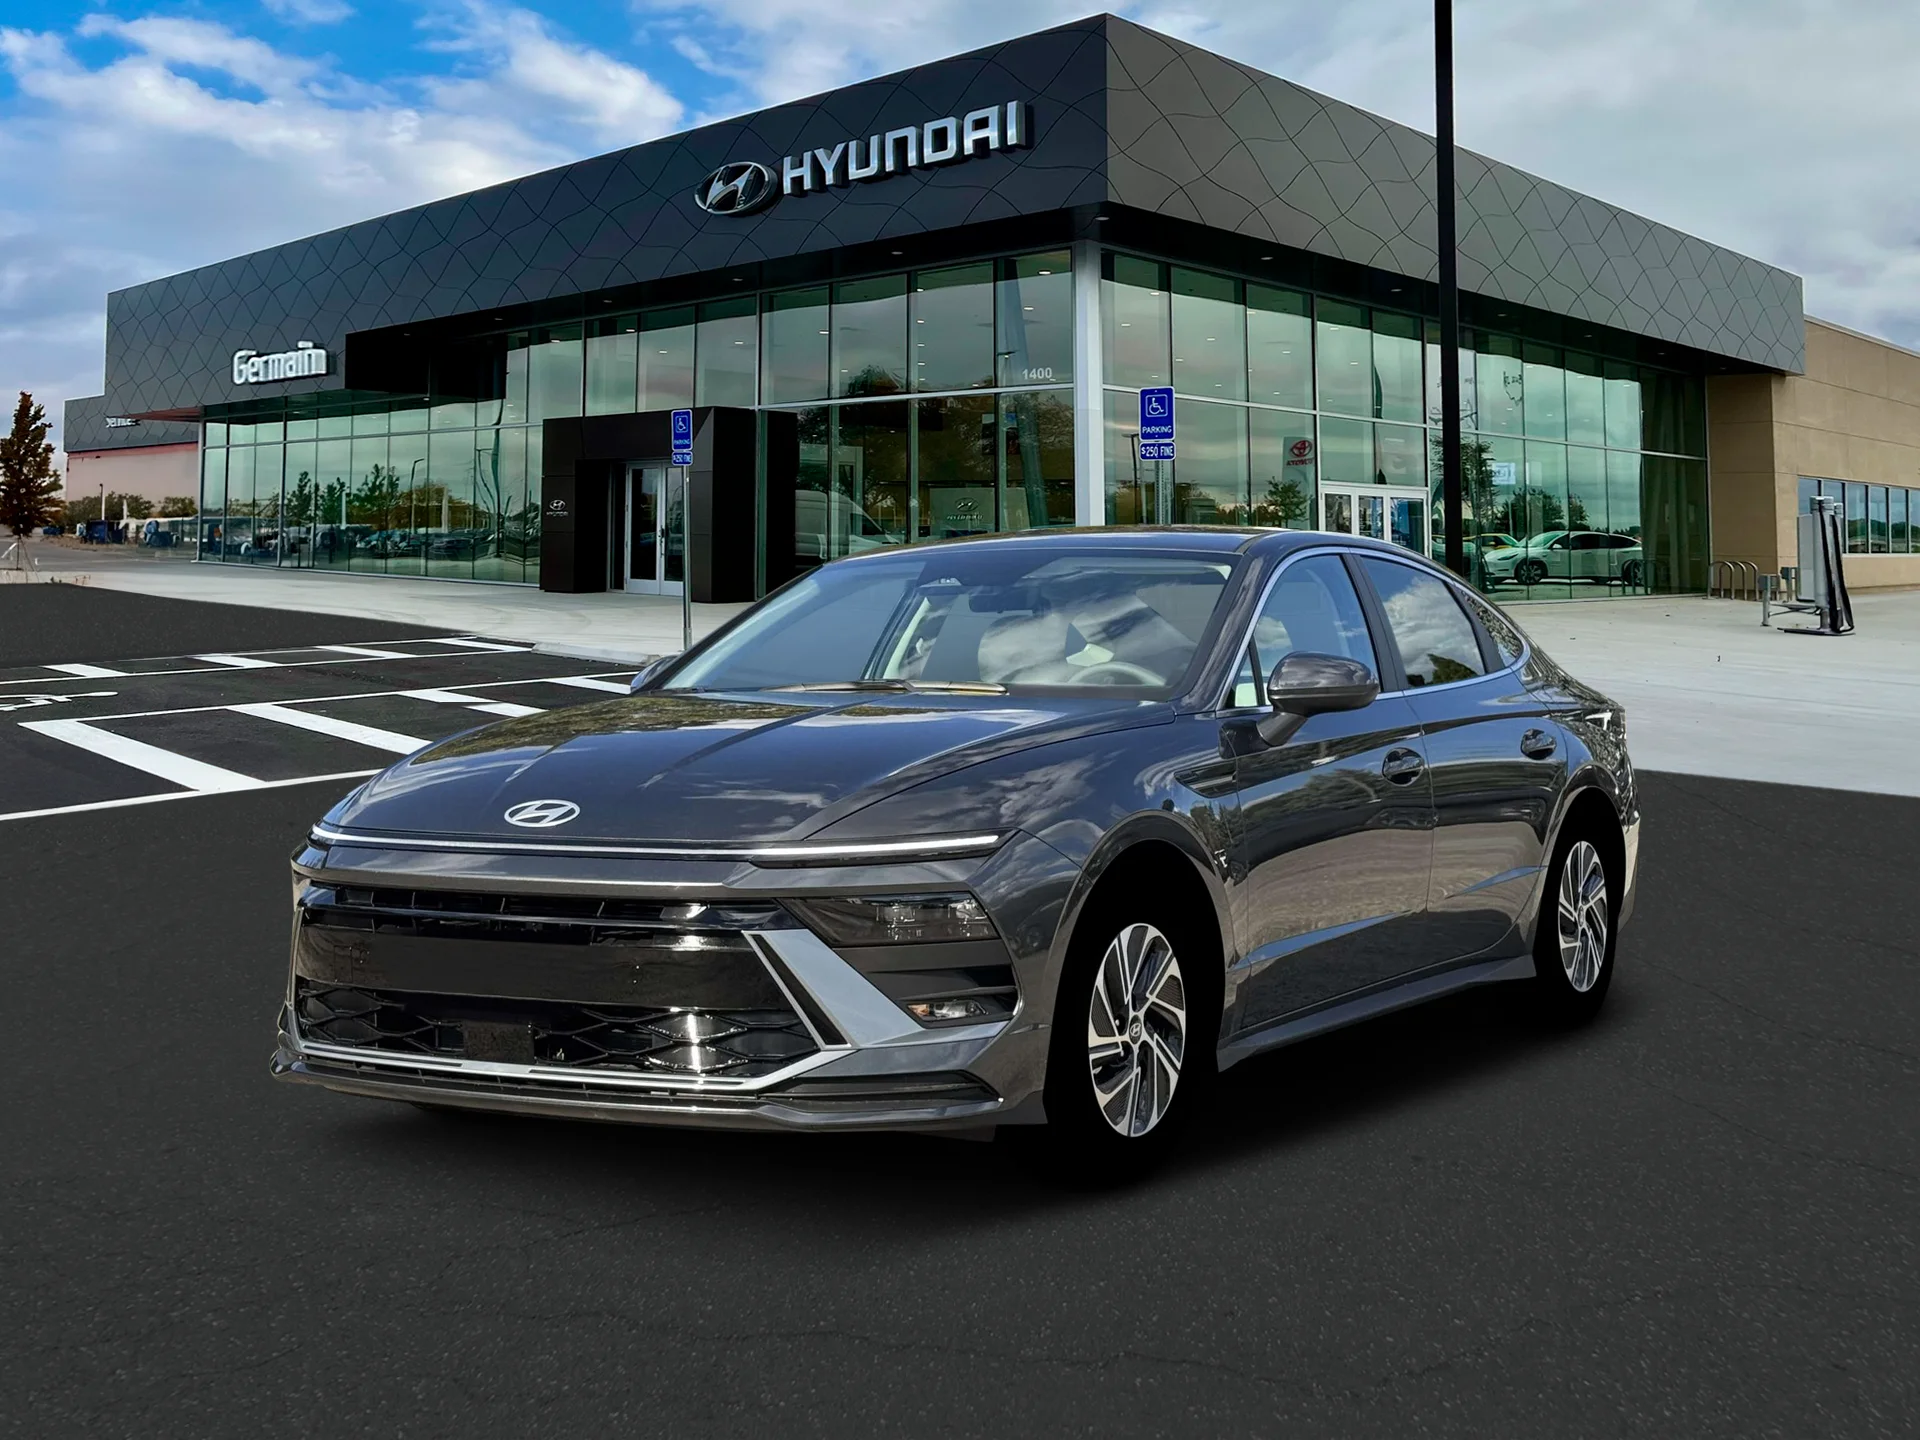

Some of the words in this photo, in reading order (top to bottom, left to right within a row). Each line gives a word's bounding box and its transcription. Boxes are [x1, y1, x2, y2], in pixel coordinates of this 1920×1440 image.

[783, 100, 1026, 195] HYUNDAI
[233, 340, 327, 385] Germain
[1022, 367, 1052, 380] 1400
[1142, 425, 1172, 434] PARKING
[1141, 446, 1158, 457] $250
[1160, 445, 1174, 457] FINE
